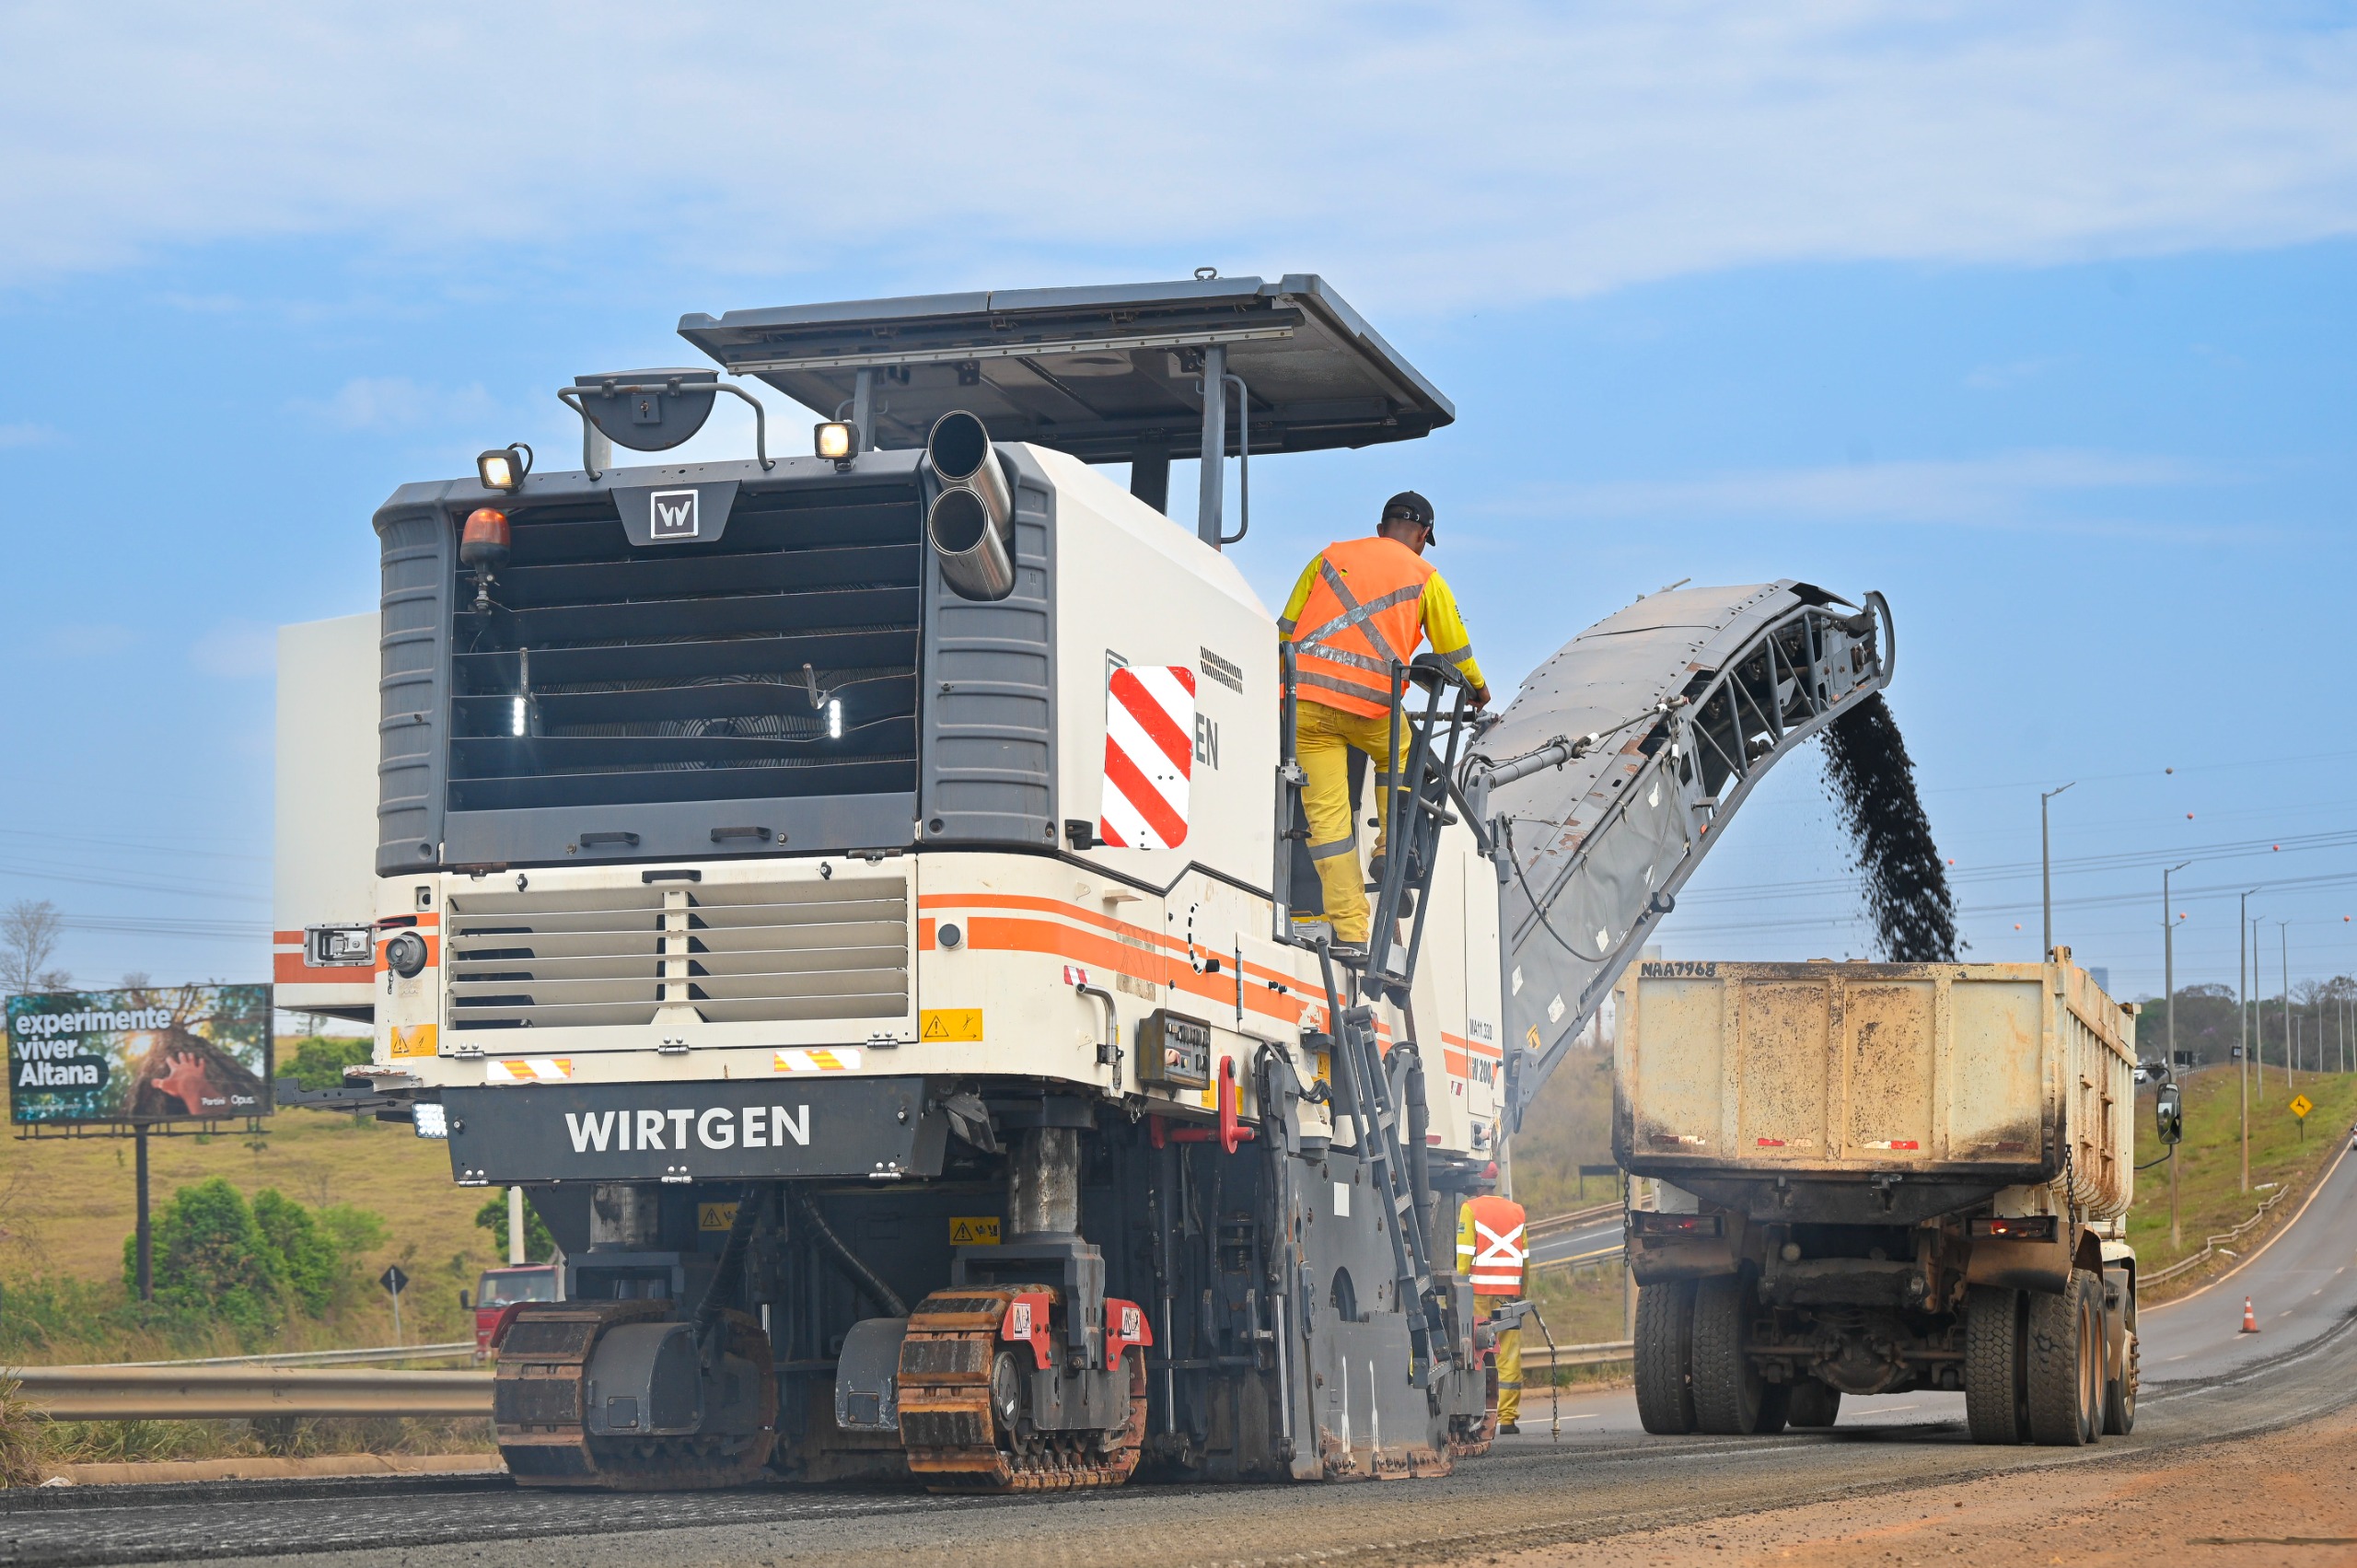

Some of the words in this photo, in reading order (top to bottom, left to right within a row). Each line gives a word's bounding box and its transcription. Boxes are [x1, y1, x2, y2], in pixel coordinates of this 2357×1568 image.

[1191, 711, 1218, 771] EN
[1641, 961, 1716, 977] NAA7968
[16, 1006, 172, 1037] experimente
[17, 1036, 78, 1061] viver
[18, 1062, 99, 1087] Altana
[565, 1104, 810, 1153] WIRTGEN
